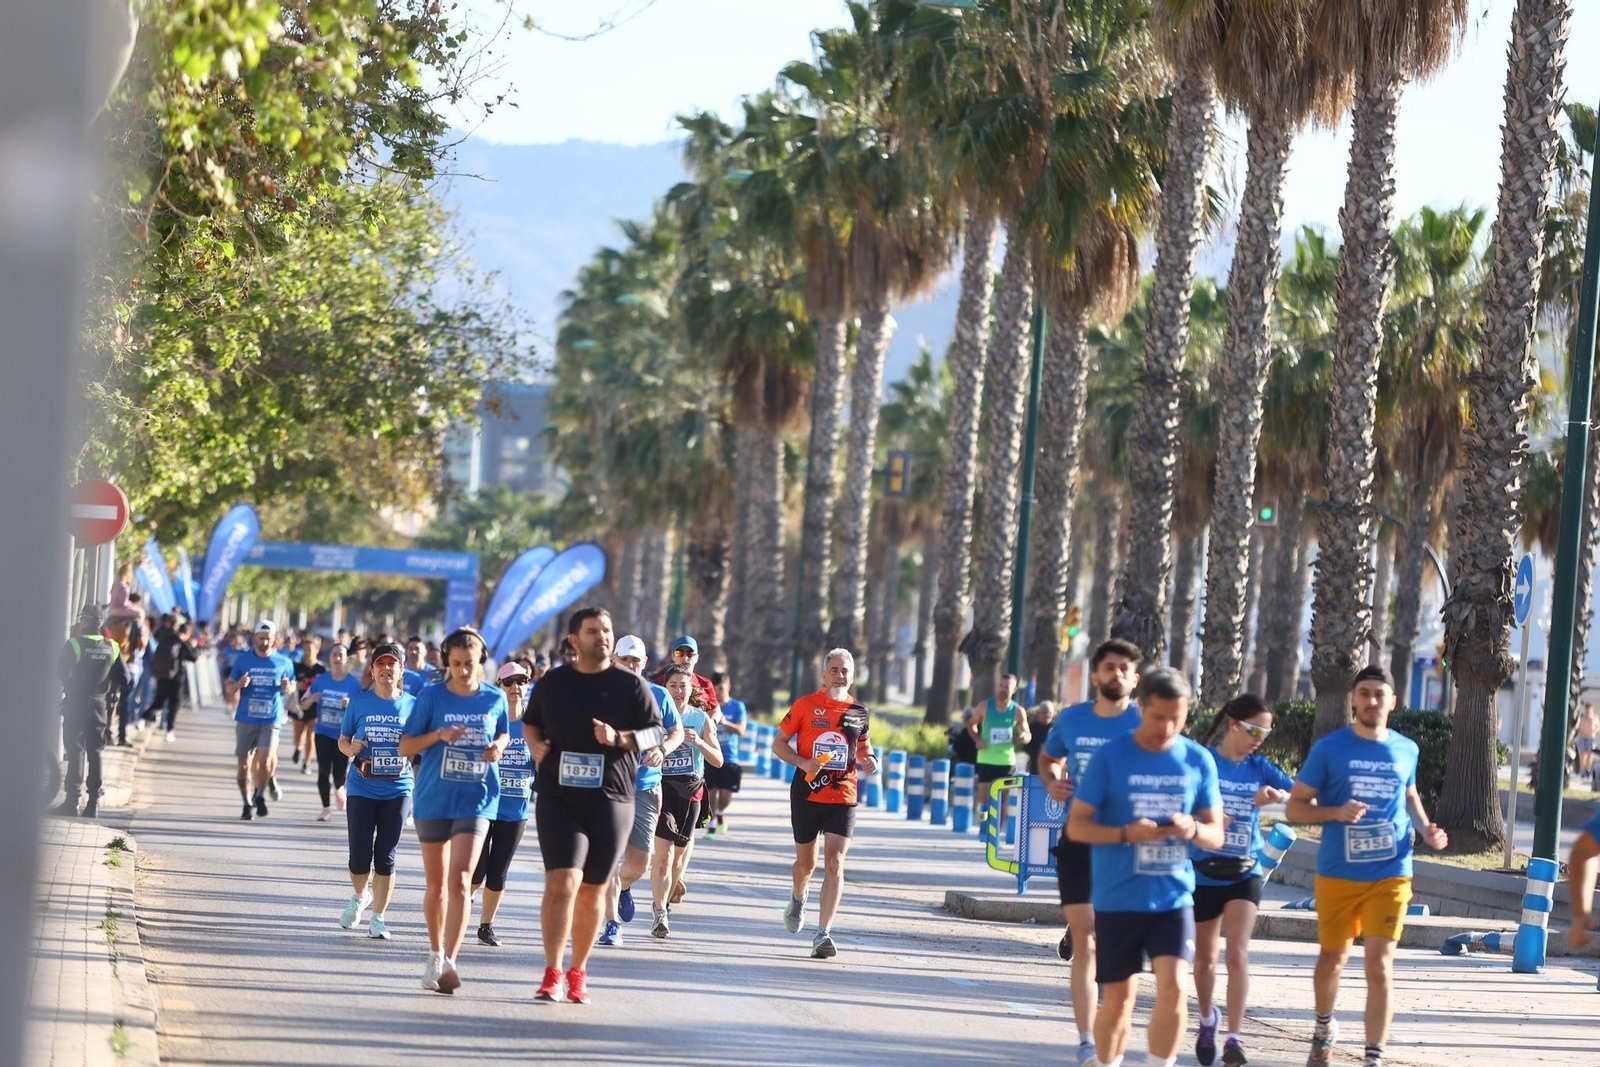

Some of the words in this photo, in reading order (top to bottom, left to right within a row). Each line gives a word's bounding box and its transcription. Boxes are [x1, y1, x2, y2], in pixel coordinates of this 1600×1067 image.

[406, 555, 469, 571] mayoral
[520, 561, 590, 626] mayoral
[366, 714, 406, 725] mayoral
[816, 752, 843, 761] 227
[449, 760, 482, 772] 1821
[664, 758, 689, 767] 1707
[1349, 760, 1403, 771] mayoral
[565, 766, 597, 776] 1879
[501, 778, 528, 788] 2133
[1128, 774, 1191, 789] mayoral
